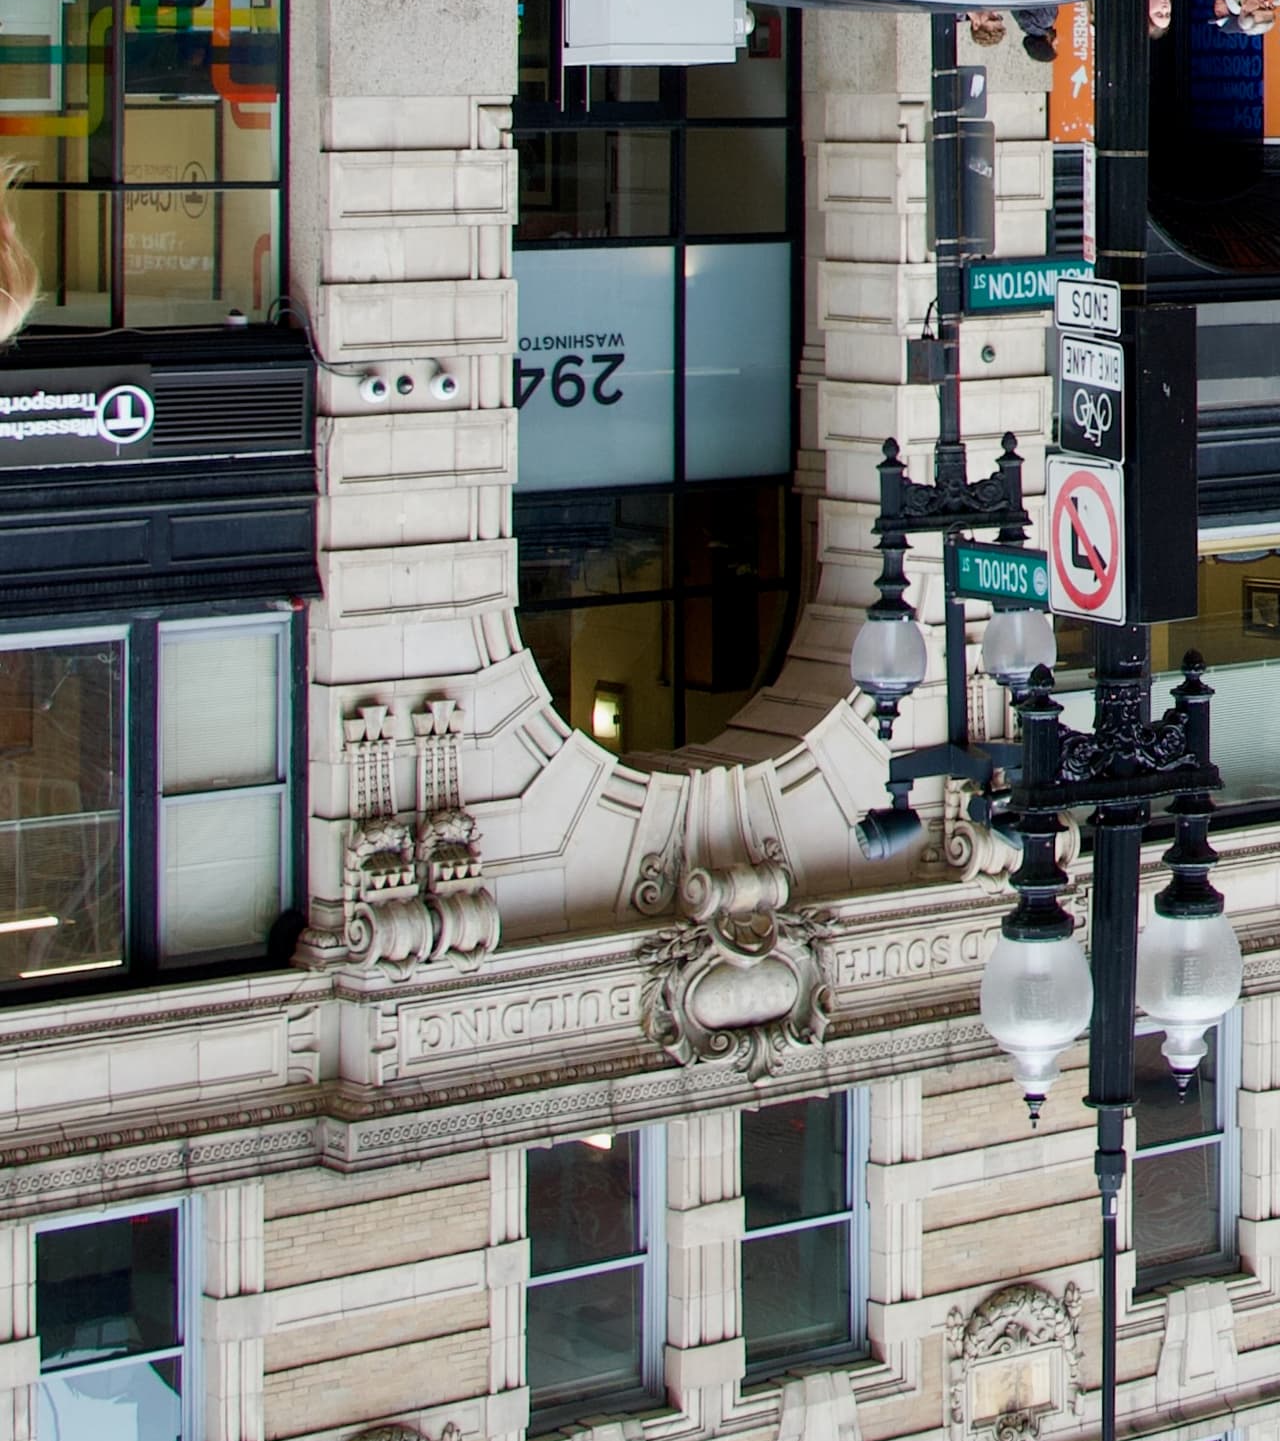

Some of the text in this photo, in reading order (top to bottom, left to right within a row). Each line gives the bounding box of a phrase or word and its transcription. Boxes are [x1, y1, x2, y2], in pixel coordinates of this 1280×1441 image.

[1072, 1, 1087, 61] TREET
[973, 267, 1094, 300] HINGTON ST
[1072, 290, 1109, 322] ENDS
[517, 333, 625, 351] WASHINGTO
[512, 353, 625, 411] 294
[1065, 346, 1119, 384] BIKE LANE
[961, 556, 1028, 594] SCHOOL ST
[833, 935, 950, 985] SOUTH
[417, 983, 636, 1055] BUILDING
